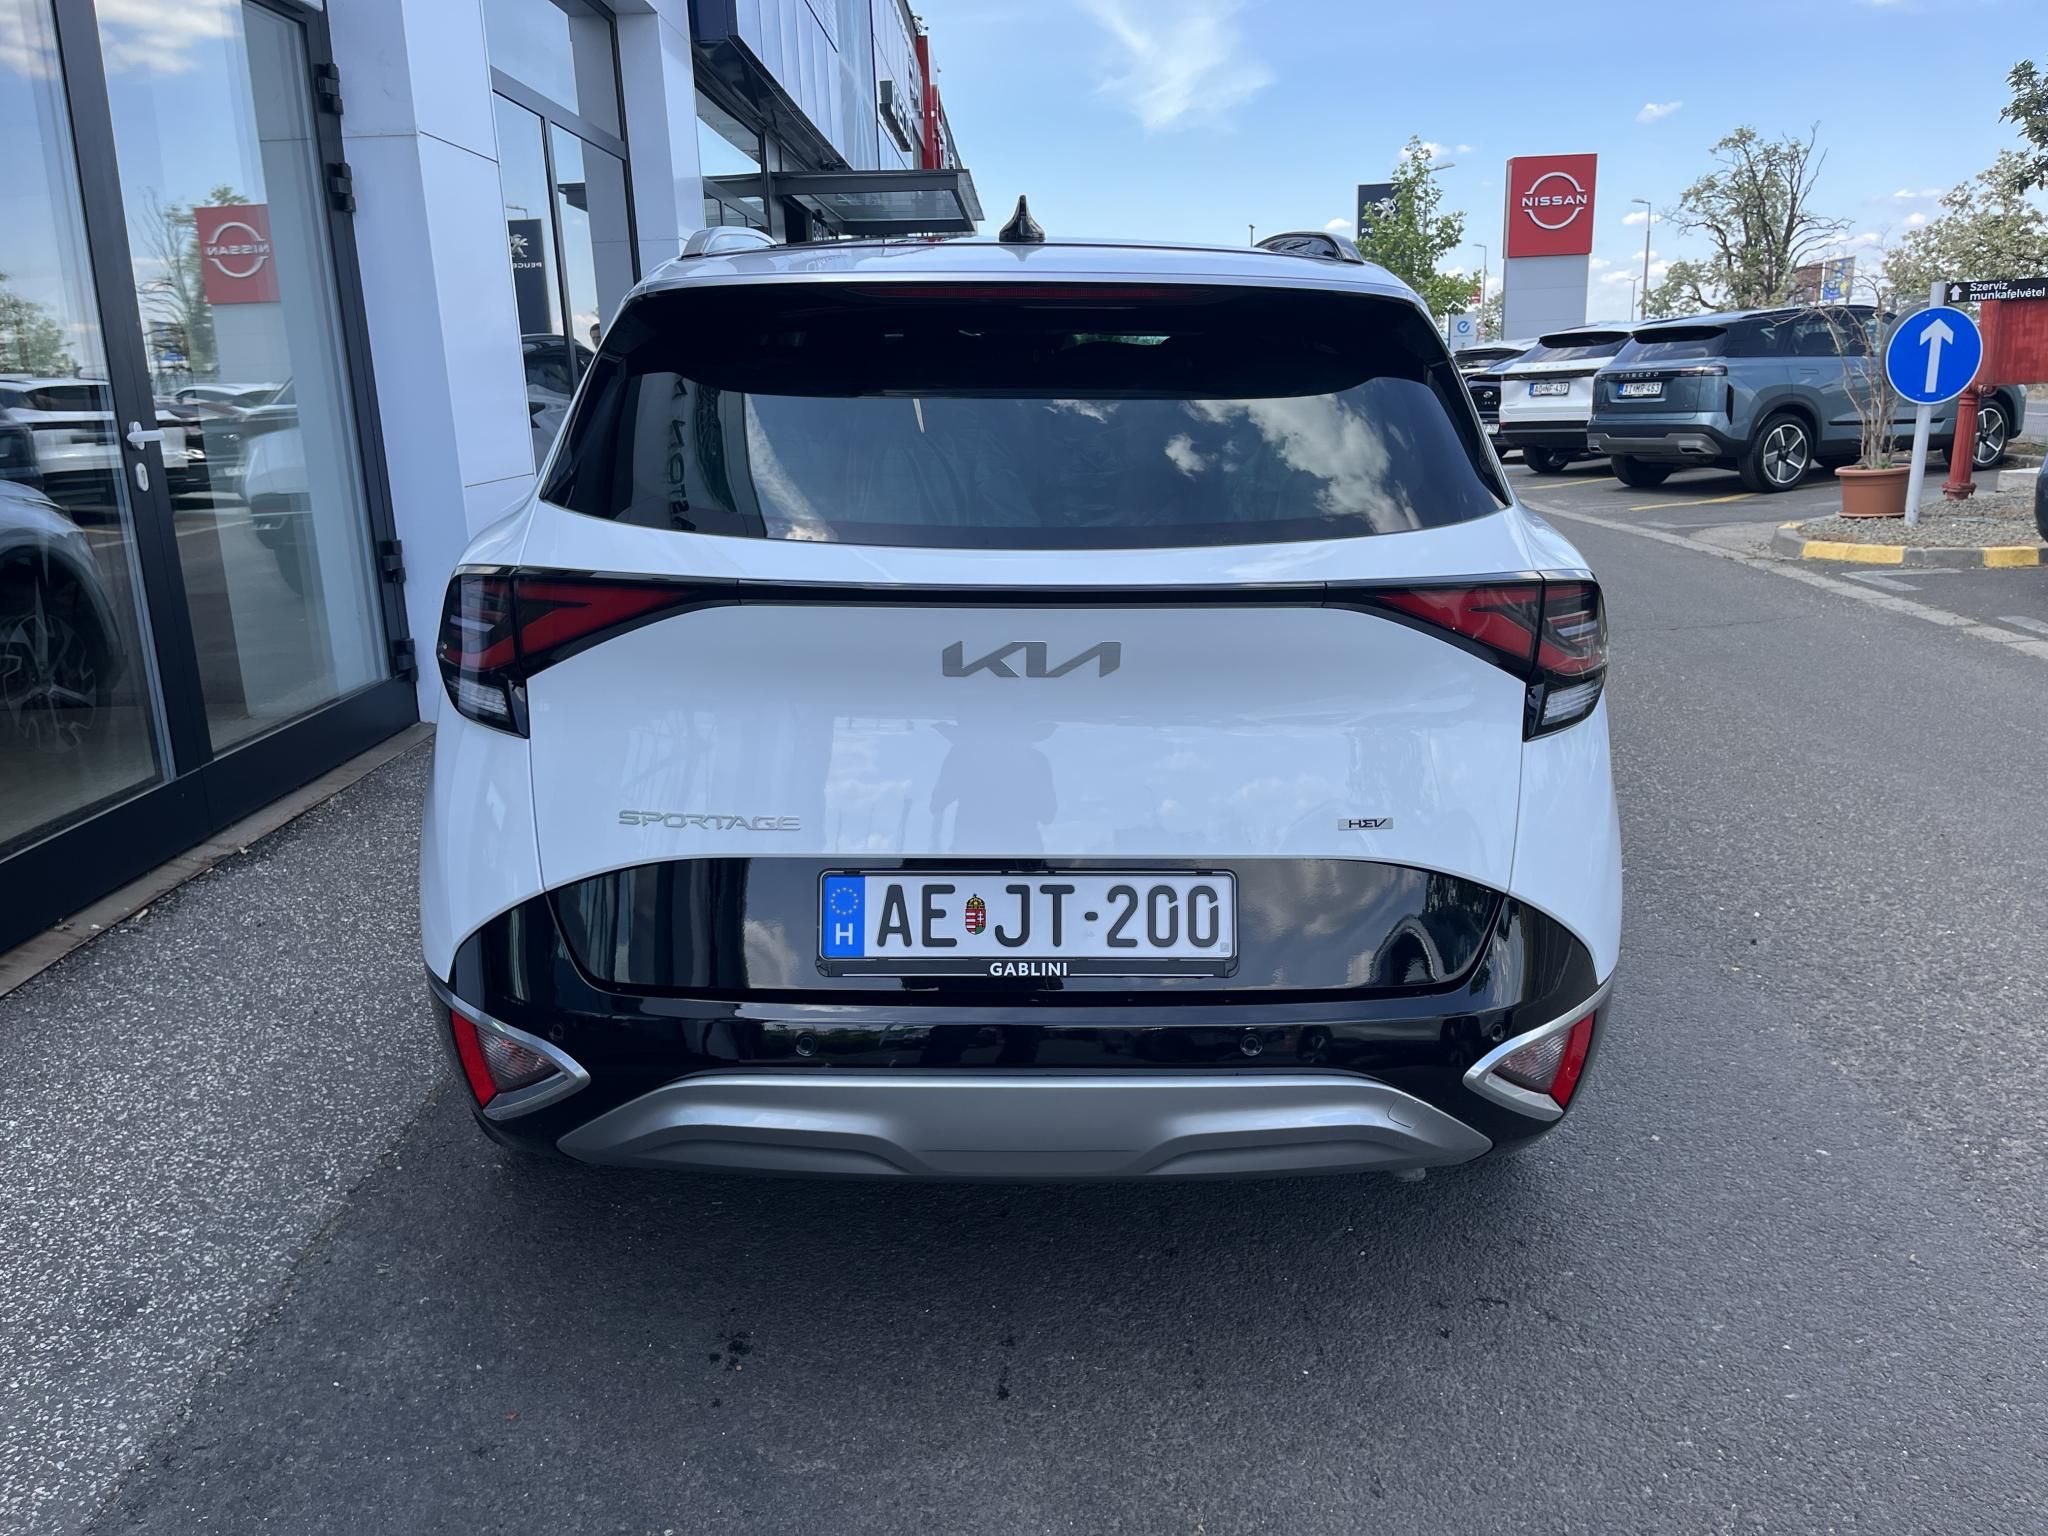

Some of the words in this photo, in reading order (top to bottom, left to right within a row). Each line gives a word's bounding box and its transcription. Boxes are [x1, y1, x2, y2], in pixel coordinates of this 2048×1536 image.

[1522, 194, 1588, 207] NISSAN
[1969, 281, 2008, 292] Szerviz
[1969, 287, 2046, 300] munkafelvétel
[942, 640, 1121, 678] KIA
[618, 809, 801, 831] SPORTAGE
[1349, 818, 1388, 828] HEV
[877, 884, 958, 948] AE
[835, 923, 854, 945] H
[989, 962, 1068, 976] GABLINI
